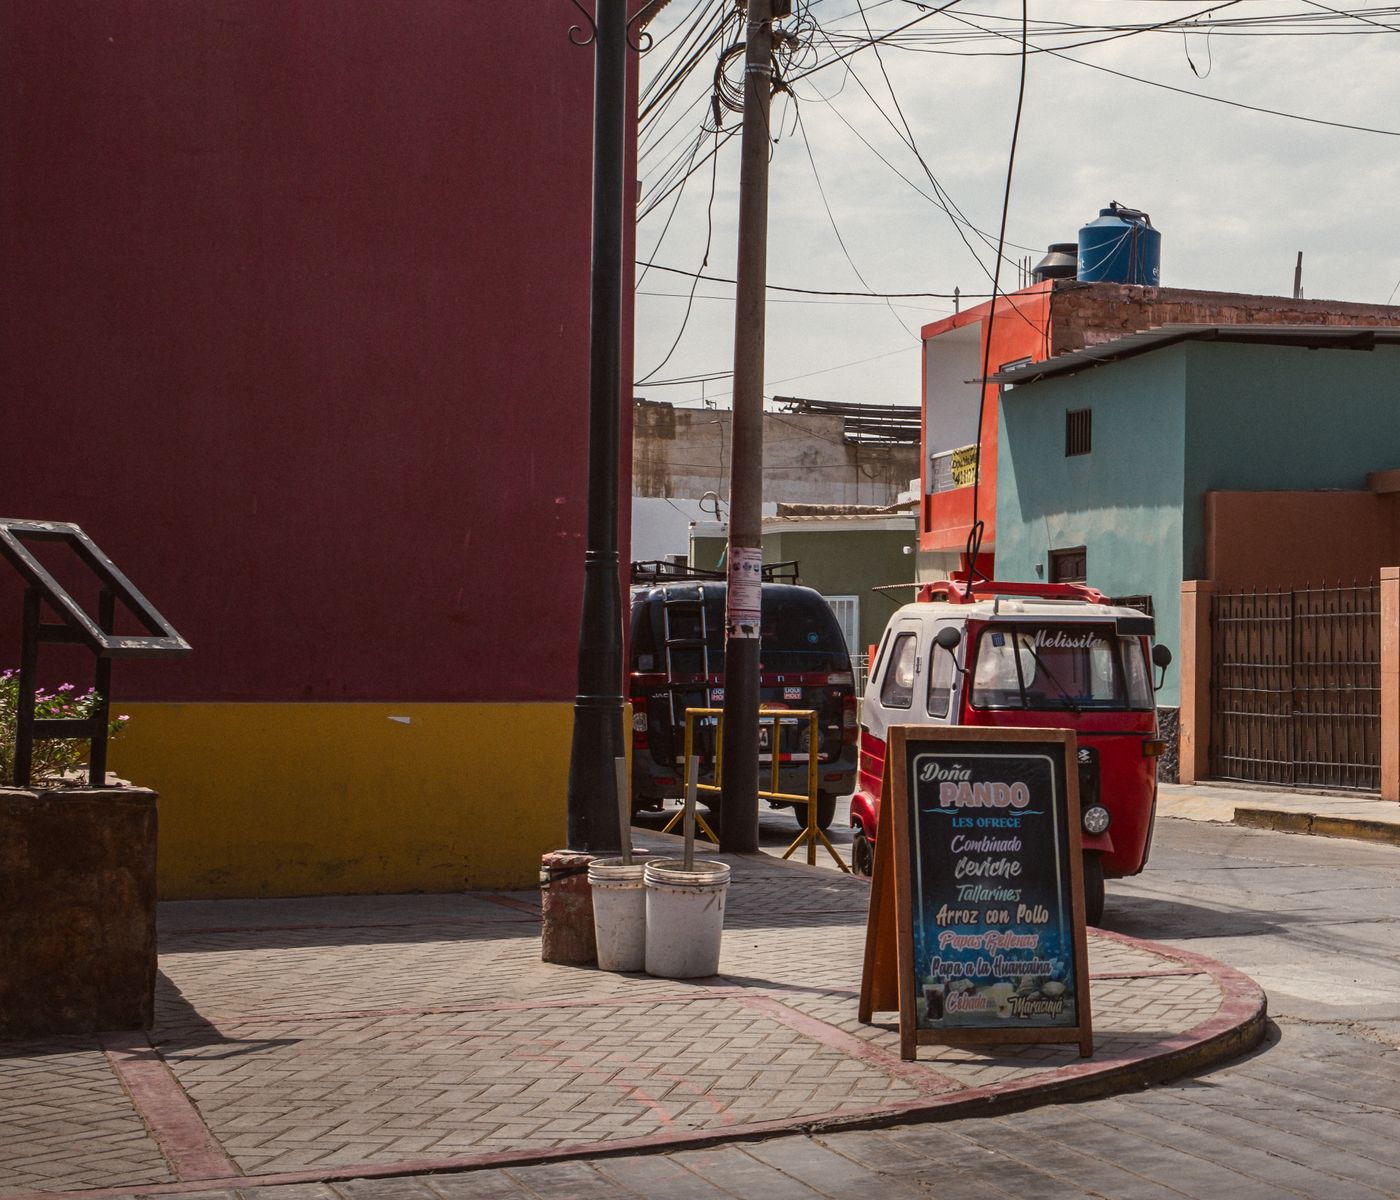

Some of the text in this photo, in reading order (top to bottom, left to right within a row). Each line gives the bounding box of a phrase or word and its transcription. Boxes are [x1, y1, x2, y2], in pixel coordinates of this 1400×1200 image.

[1034, 629, 1107, 648] Melissita
[920, 762, 971, 781] Doña
[939, 782, 1030, 808] PANDO
[952, 817, 1021, 828] LES OFRECE
[951, 835, 1022, 854] Combinado
[955, 856, 1023, 879] Ceviche
[956, 884, 1022, 903] Tallarines
[935, 903, 1049, 927] Arroz con Pollo
[937, 930, 1039, 957] Papas Rellenas
[931, 956, 963, 980] Papa
[965, 963, 975, 976] a
[975, 956, 991, 977] la
[1007, 996, 1064, 1020] Maracuyá
